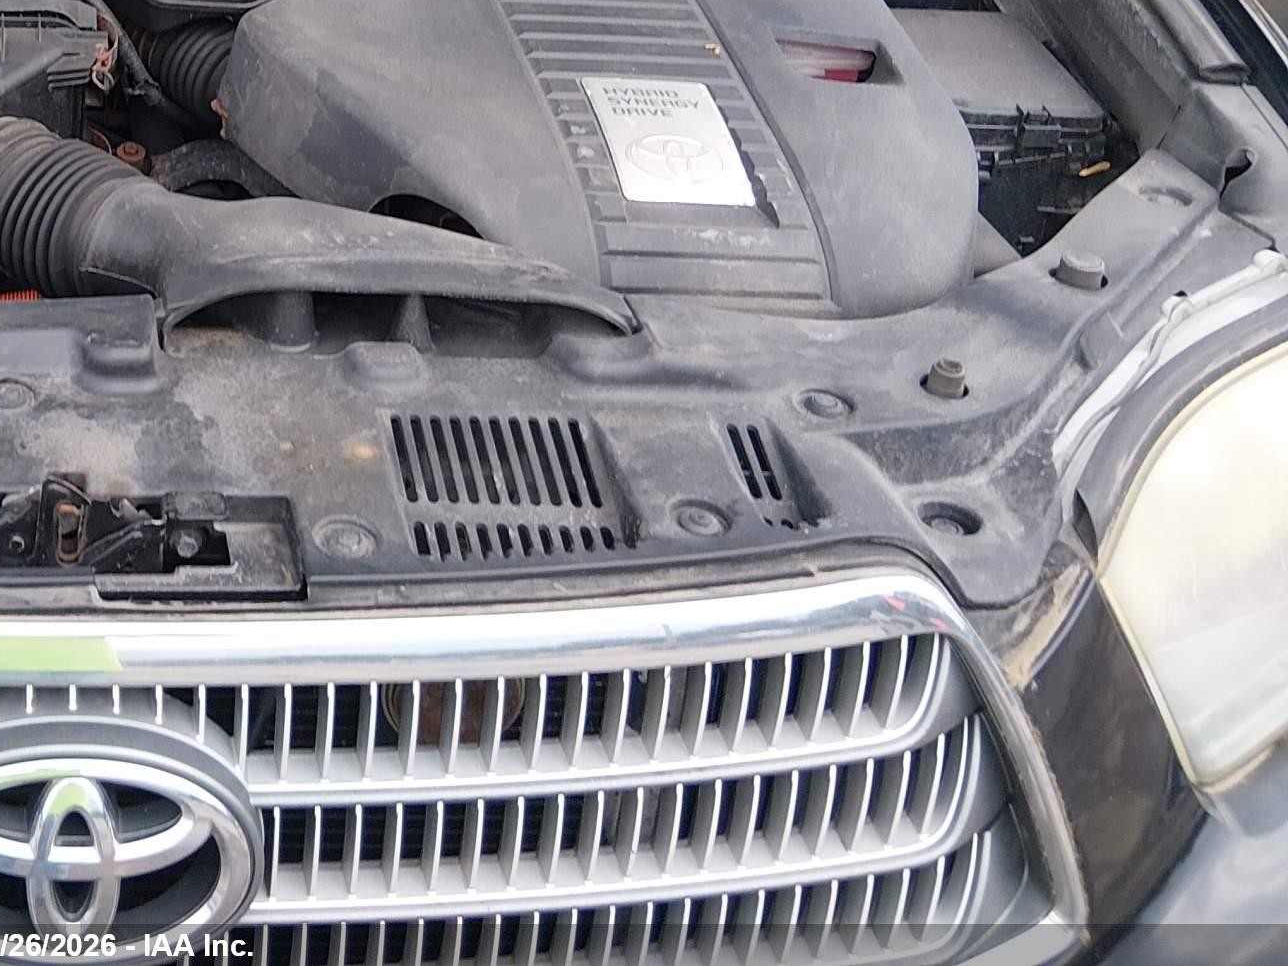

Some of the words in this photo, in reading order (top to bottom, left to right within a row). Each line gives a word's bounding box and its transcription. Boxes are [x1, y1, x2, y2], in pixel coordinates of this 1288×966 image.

[602, 87, 679, 98] HYBRID
[607, 96, 699, 110] SYNERGY
[612, 107, 674, 117] DRIVE
